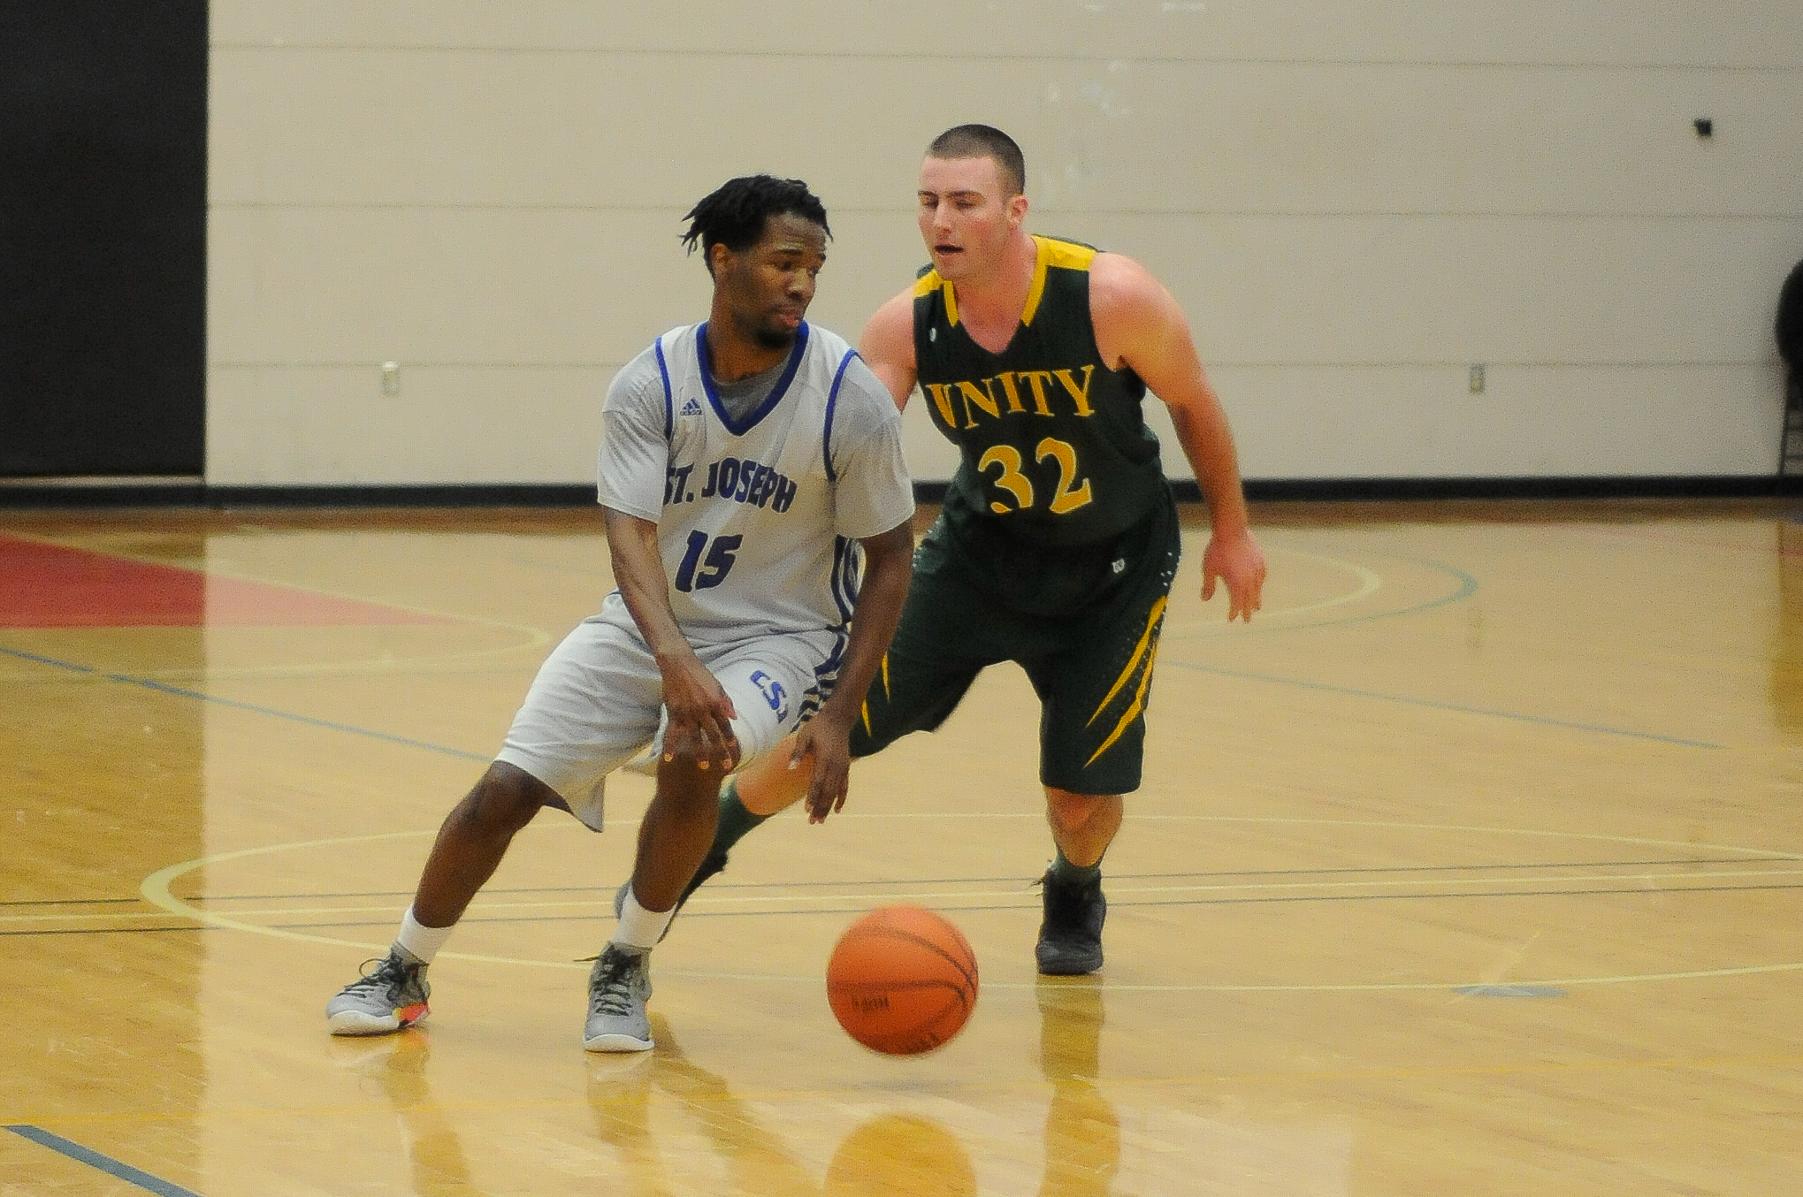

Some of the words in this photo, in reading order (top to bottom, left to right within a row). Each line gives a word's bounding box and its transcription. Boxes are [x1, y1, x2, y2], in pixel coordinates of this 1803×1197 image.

[701, 457, 798, 514] JOSEPH
[977, 437, 1093, 514] 32
[674, 529, 744, 593] 15
